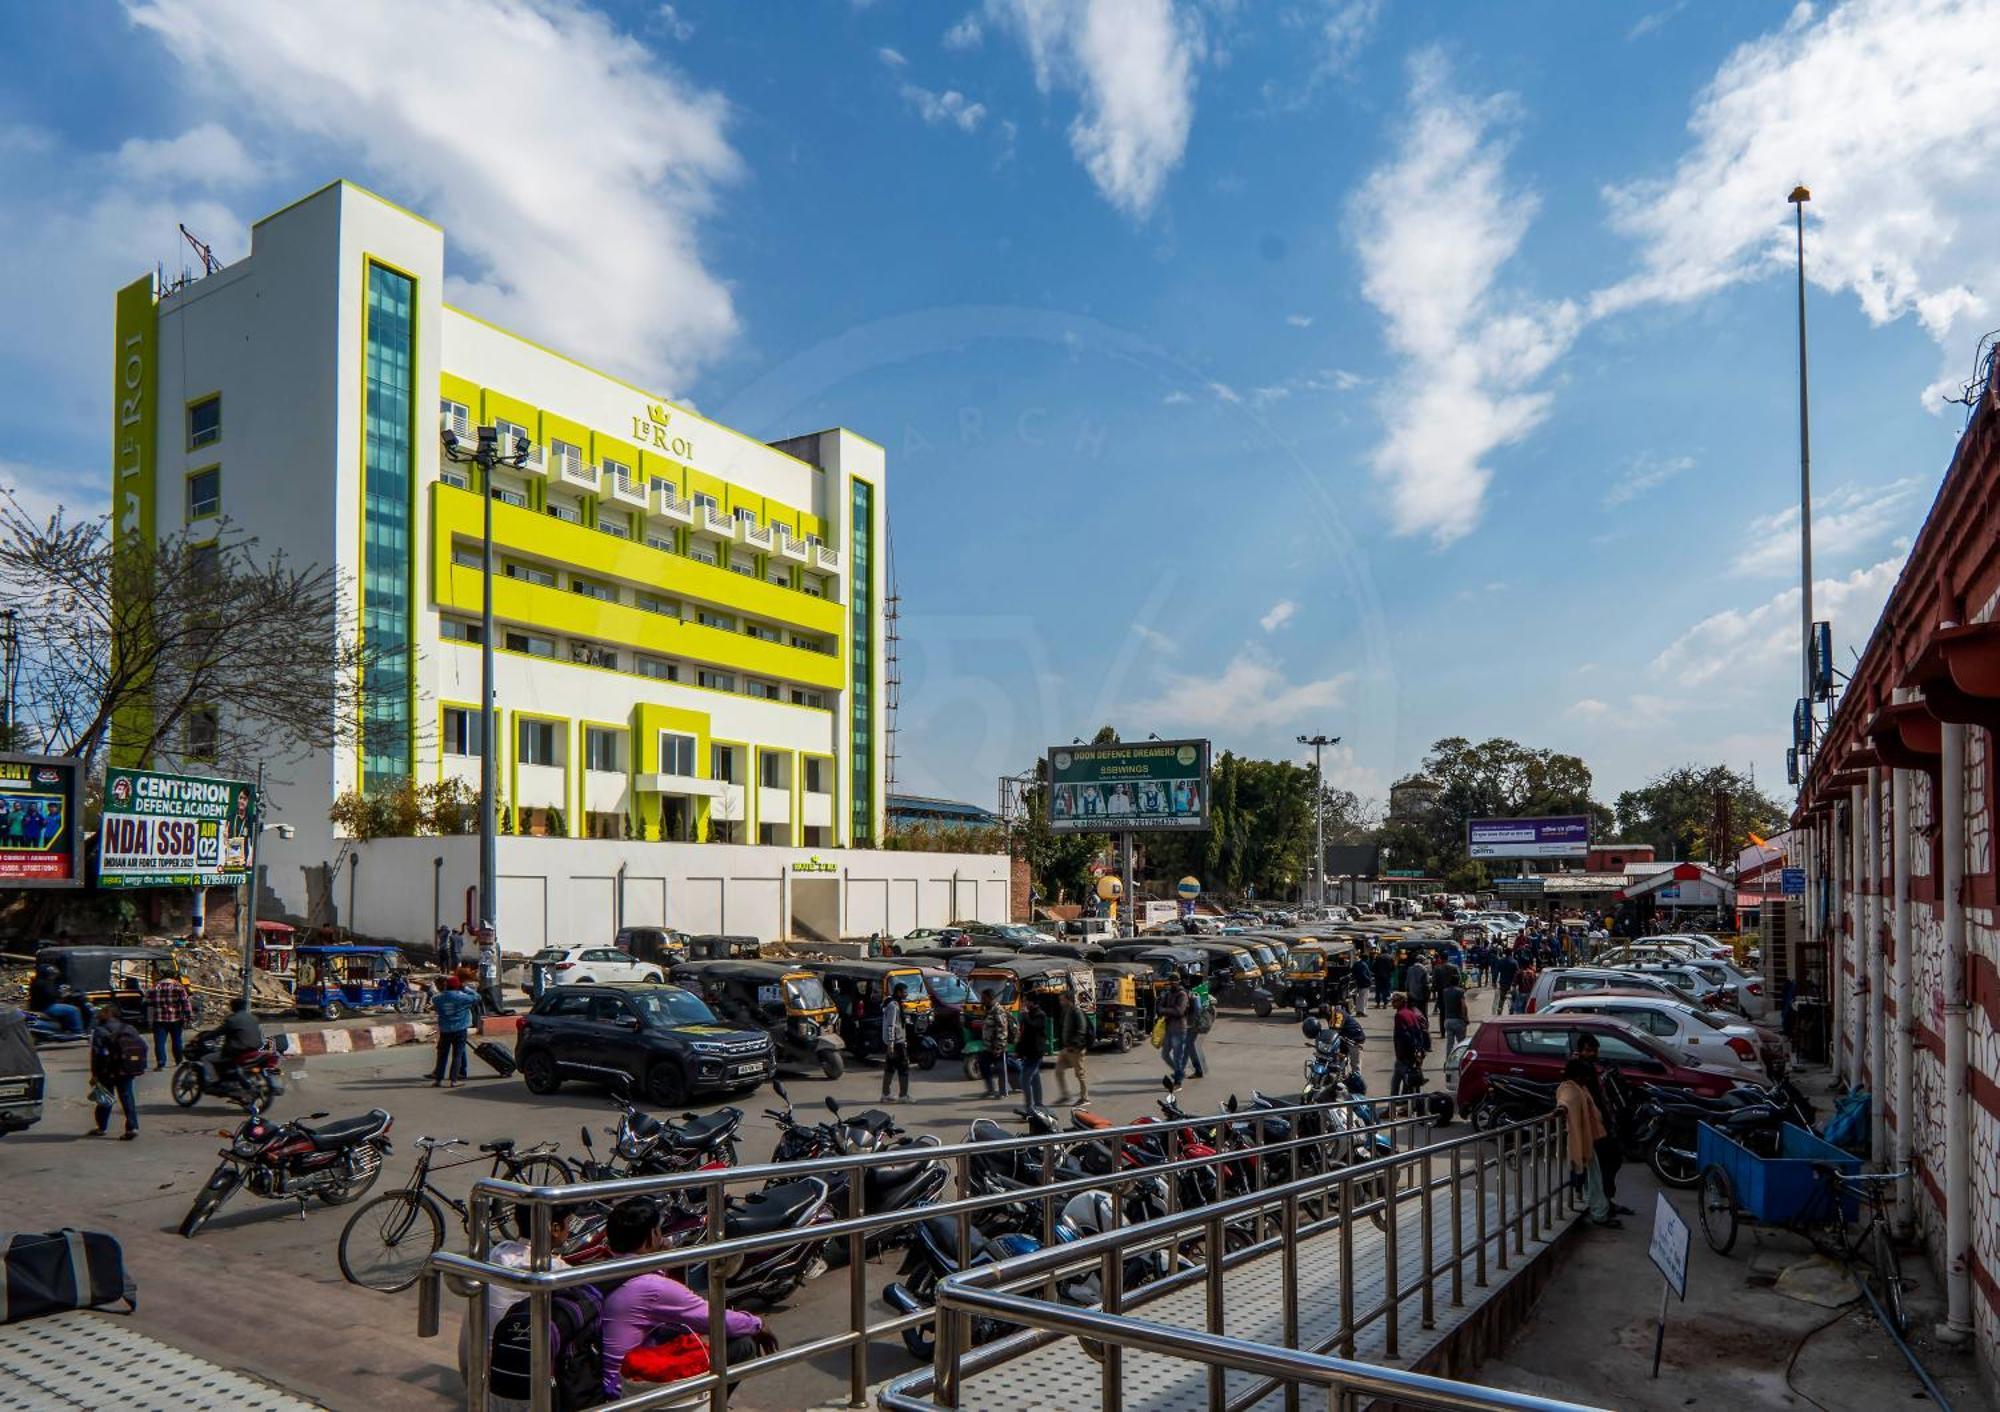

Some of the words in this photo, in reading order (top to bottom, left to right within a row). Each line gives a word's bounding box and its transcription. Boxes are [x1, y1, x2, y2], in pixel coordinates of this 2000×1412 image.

[121, 329, 144, 428] ROI
[652, 424, 694, 461] ROI
[1097, 749, 1132, 760] DEFENCE
[1133, 747, 1176, 758] DREAMERS
[136, 777, 230, 804] CENTURION
[135, 798, 182, 815] DEFENCE
[183, 803, 229, 819] ACADEMY
[105, 818, 147, 854] NDA
[157, 820, 196, 856] SSB
[200, 821, 218, 837] AIR
[199, 836, 217, 858] 02
[104, 857, 126, 868] INDIAN
[127, 857, 138, 868] AIR
[139, 858, 157, 868] FORCE
[158, 858, 180, 868] TOPPER
